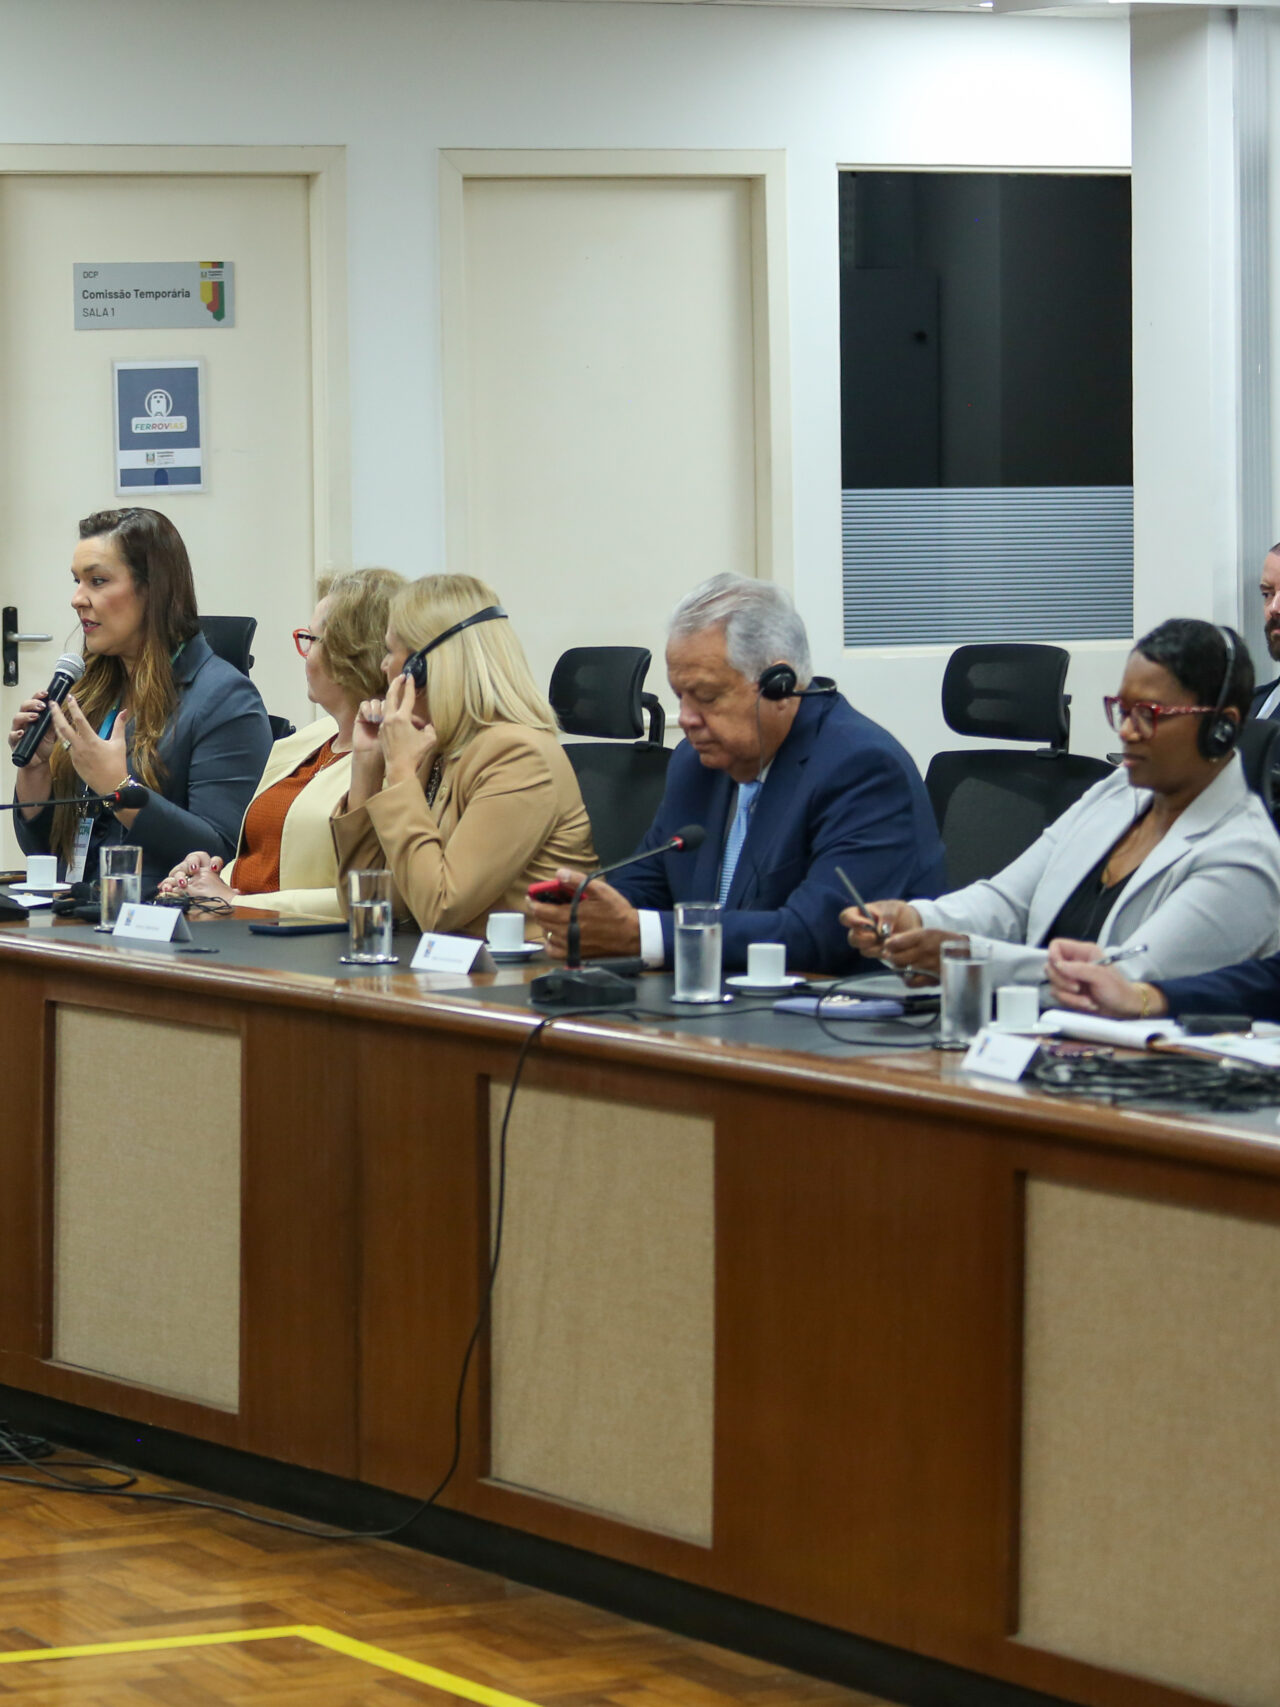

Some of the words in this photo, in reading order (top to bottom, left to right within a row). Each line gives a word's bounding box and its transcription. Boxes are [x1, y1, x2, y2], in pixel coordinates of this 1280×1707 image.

[82, 271, 99, 279] DCP
[81, 289, 132, 300] Comissão
[133, 288, 191, 301] Temporária
[82, 307, 109, 317] SALA
[111, 307, 115, 317] 1
[135, 422, 185, 431] FERROVIAS
